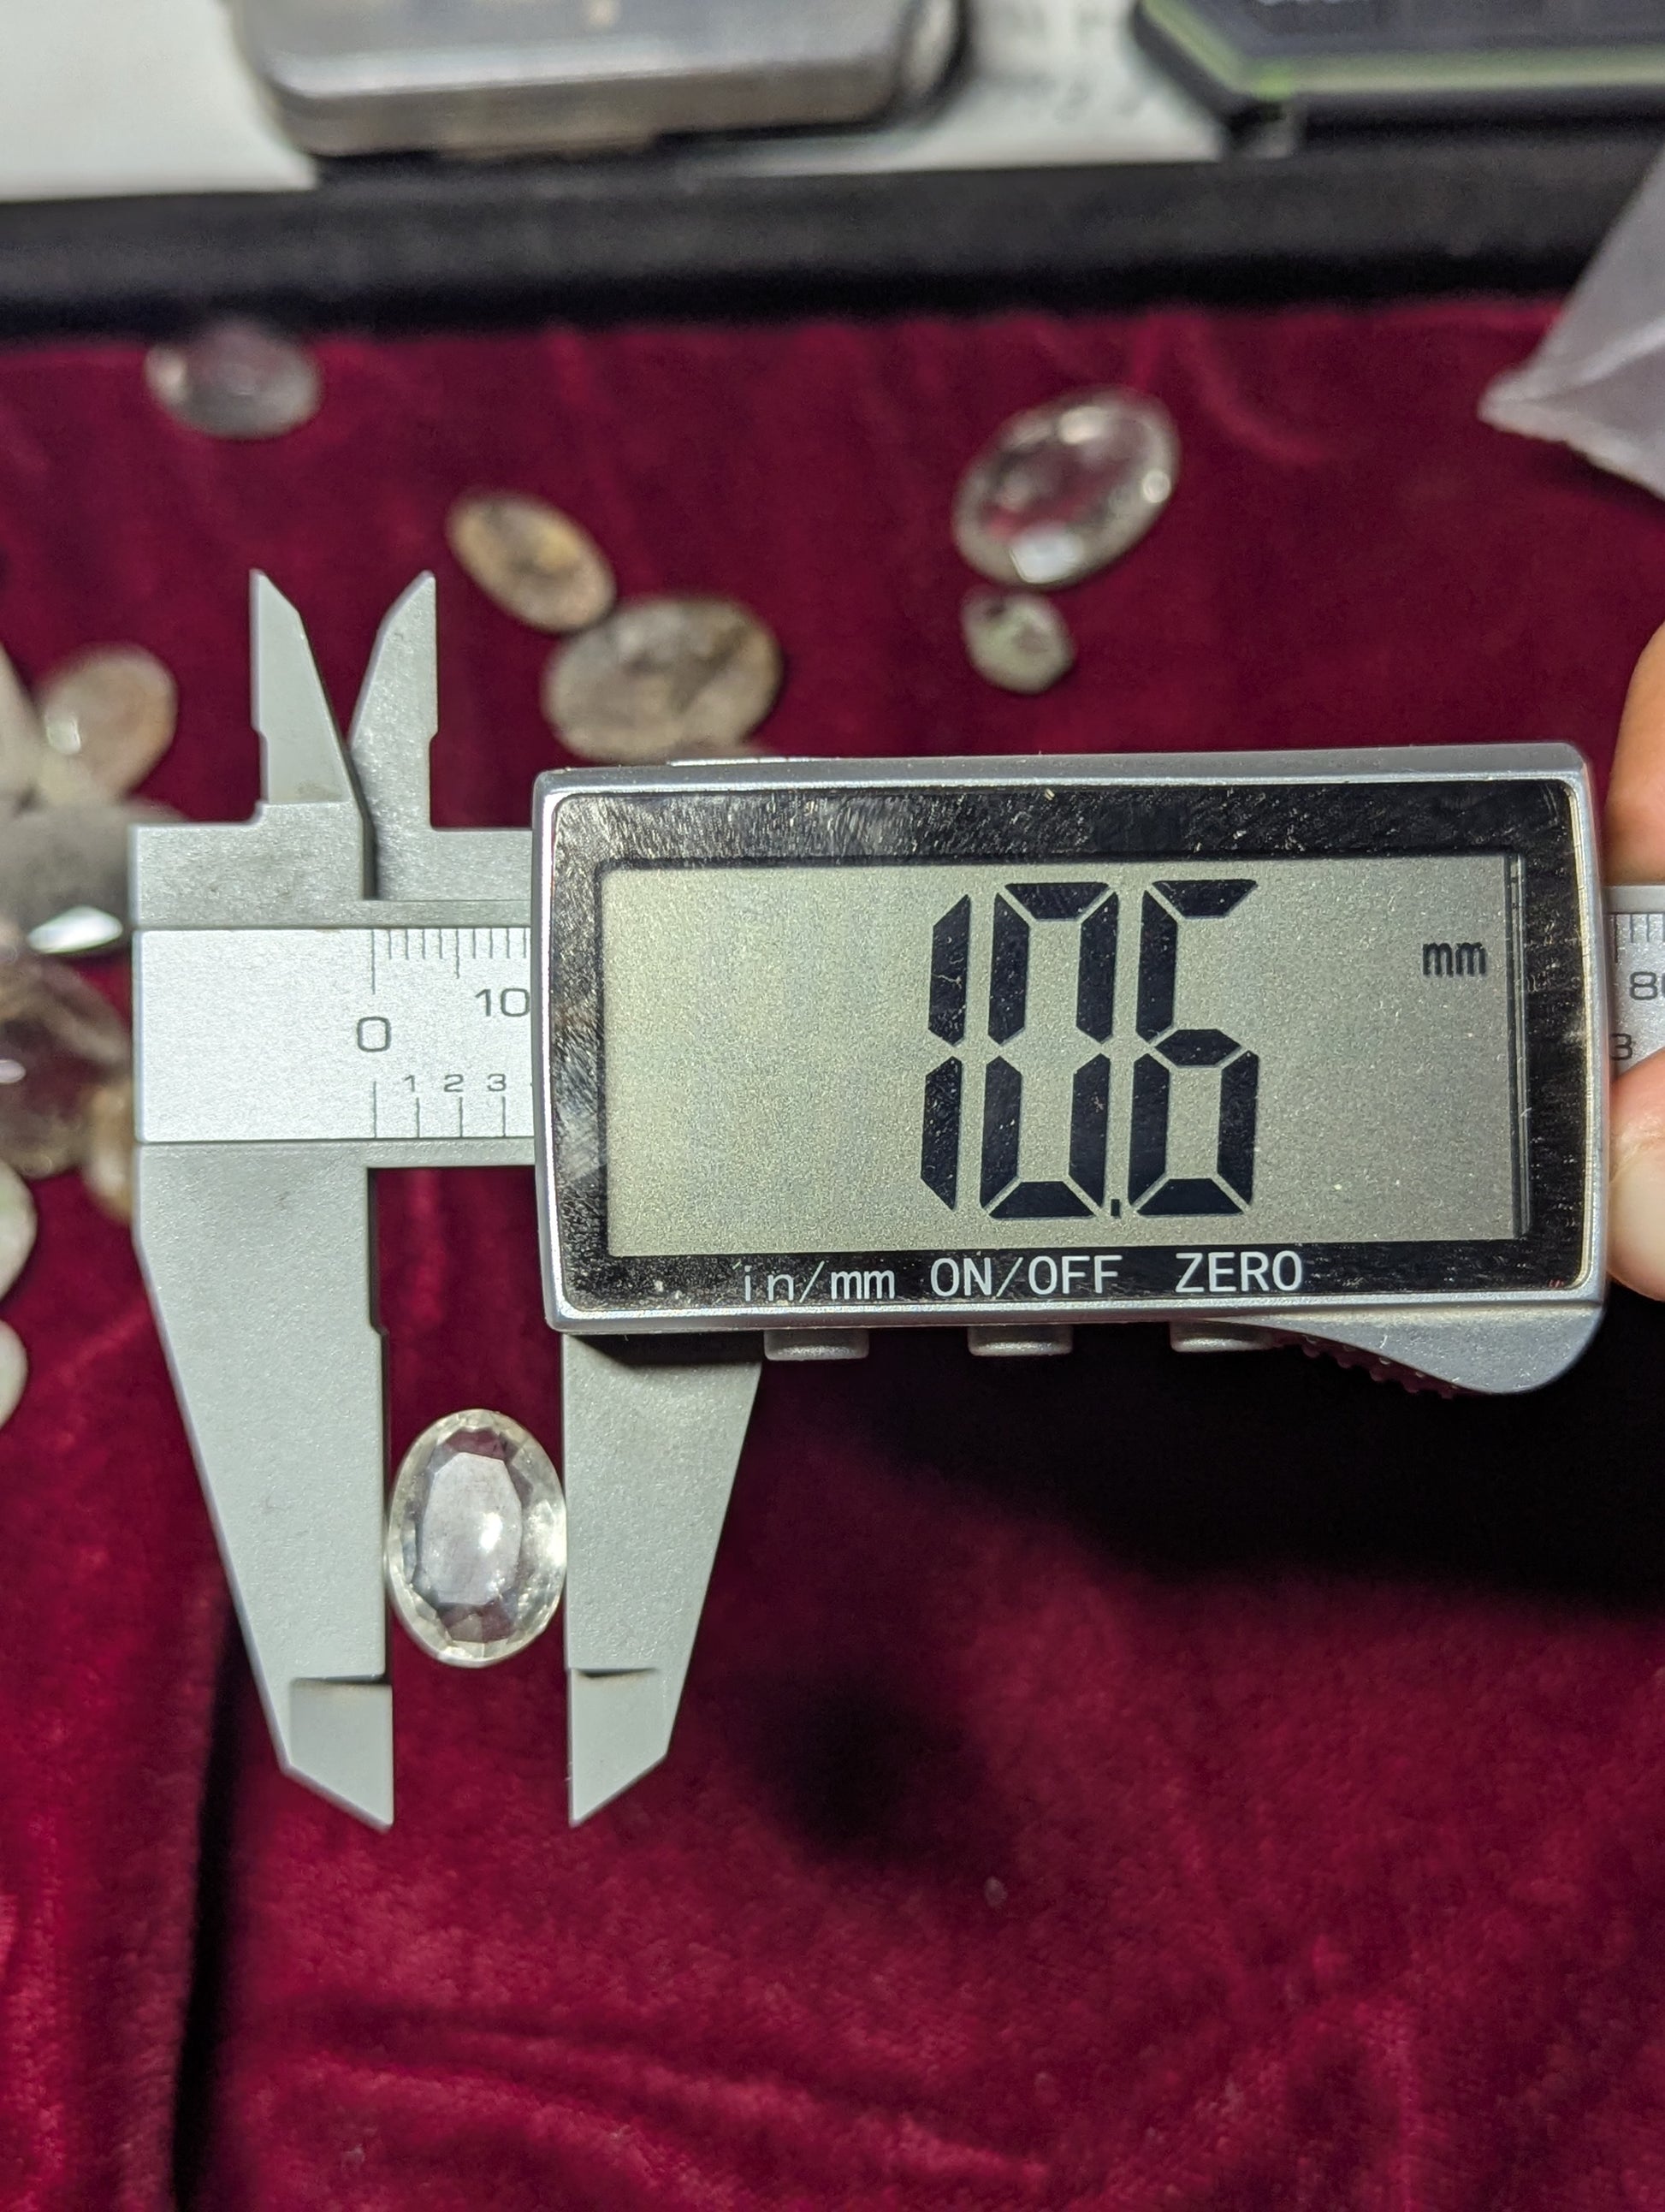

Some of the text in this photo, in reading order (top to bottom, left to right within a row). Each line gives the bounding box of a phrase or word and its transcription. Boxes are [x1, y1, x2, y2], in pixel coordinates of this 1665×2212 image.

[1422, 942, 1487, 976] mm
[1628, 970, 1665, 1001] 8
[475, 987, 530, 1017] 10
[356, 1016, 392, 1053] 0
[921, 879, 1259, 1219] 10.6
[1609, 1032, 1633, 1061] 3
[403, 1072, 507, 1093] 1 2 3
[743, 1250, 1302, 1302] in/mm ON/OFF ZERO
